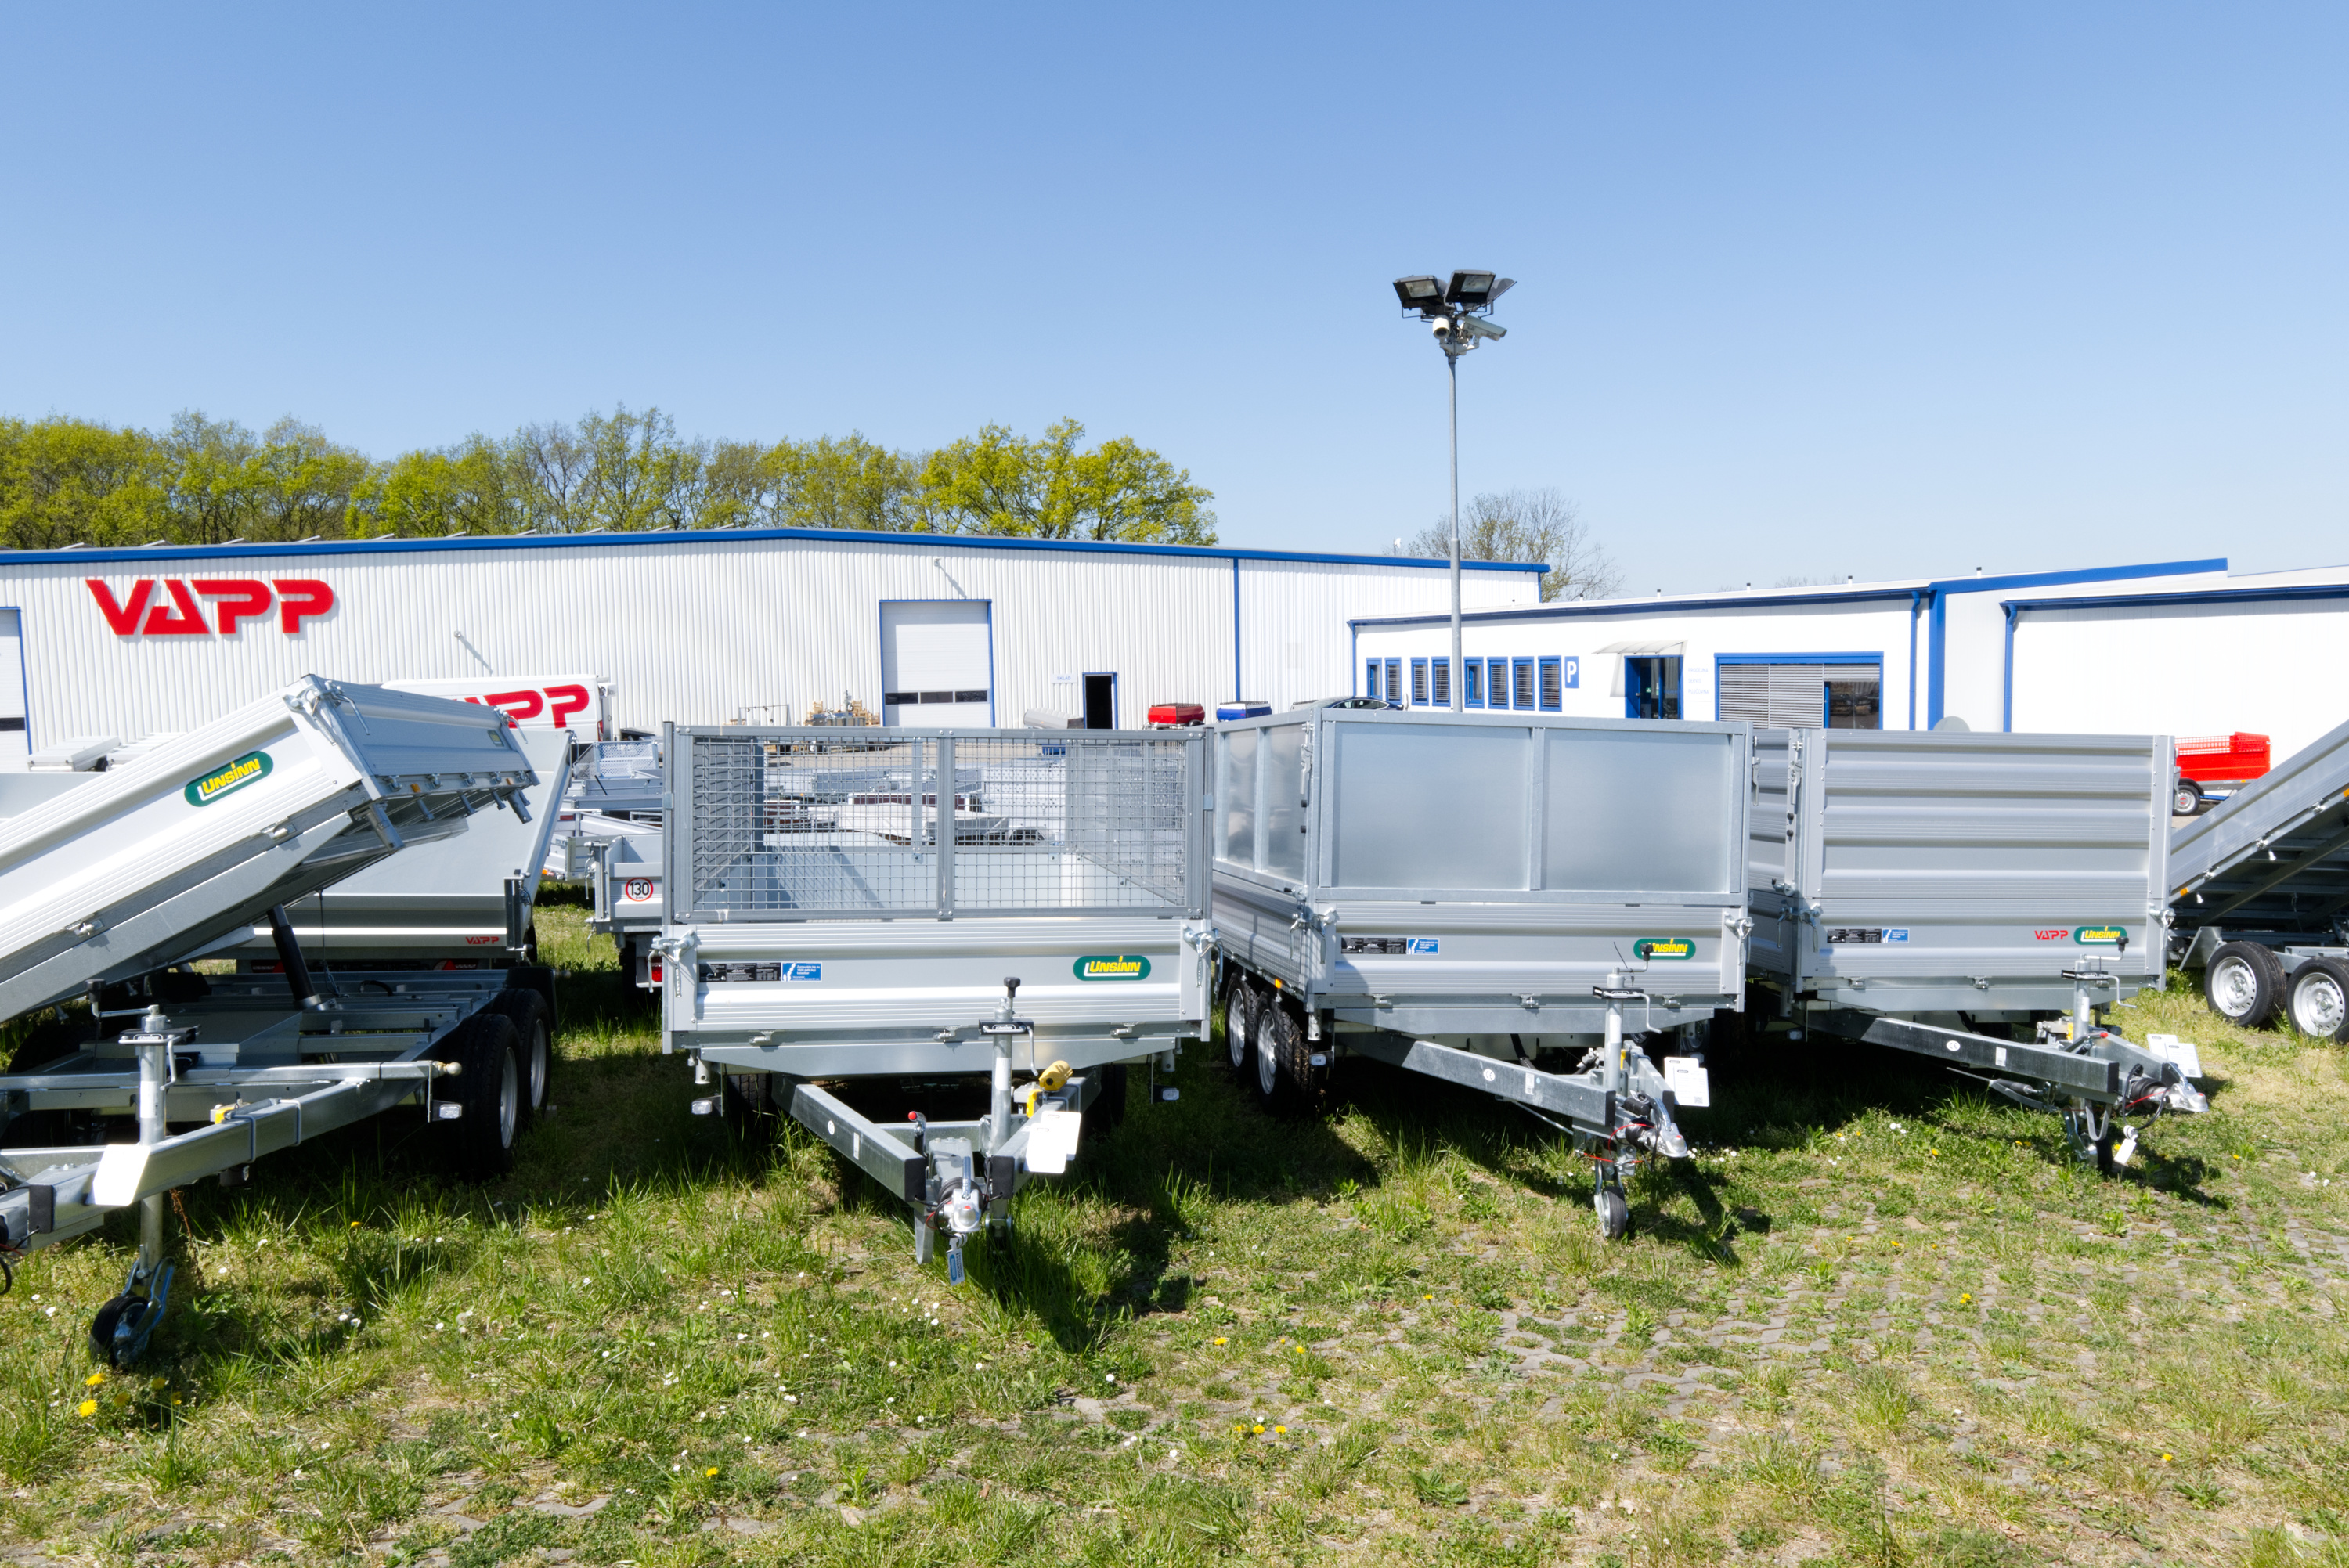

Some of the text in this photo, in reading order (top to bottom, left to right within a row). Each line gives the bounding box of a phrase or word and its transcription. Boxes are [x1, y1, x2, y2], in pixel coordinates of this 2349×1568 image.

[85, 579, 334, 635] VAPP
[1567, 661, 1577, 683] P
[453, 684, 590, 729] PP
[630, 882, 649, 896] 130
[465, 936, 500, 945] VAPP
[2034, 930, 2069, 940] VAPP
